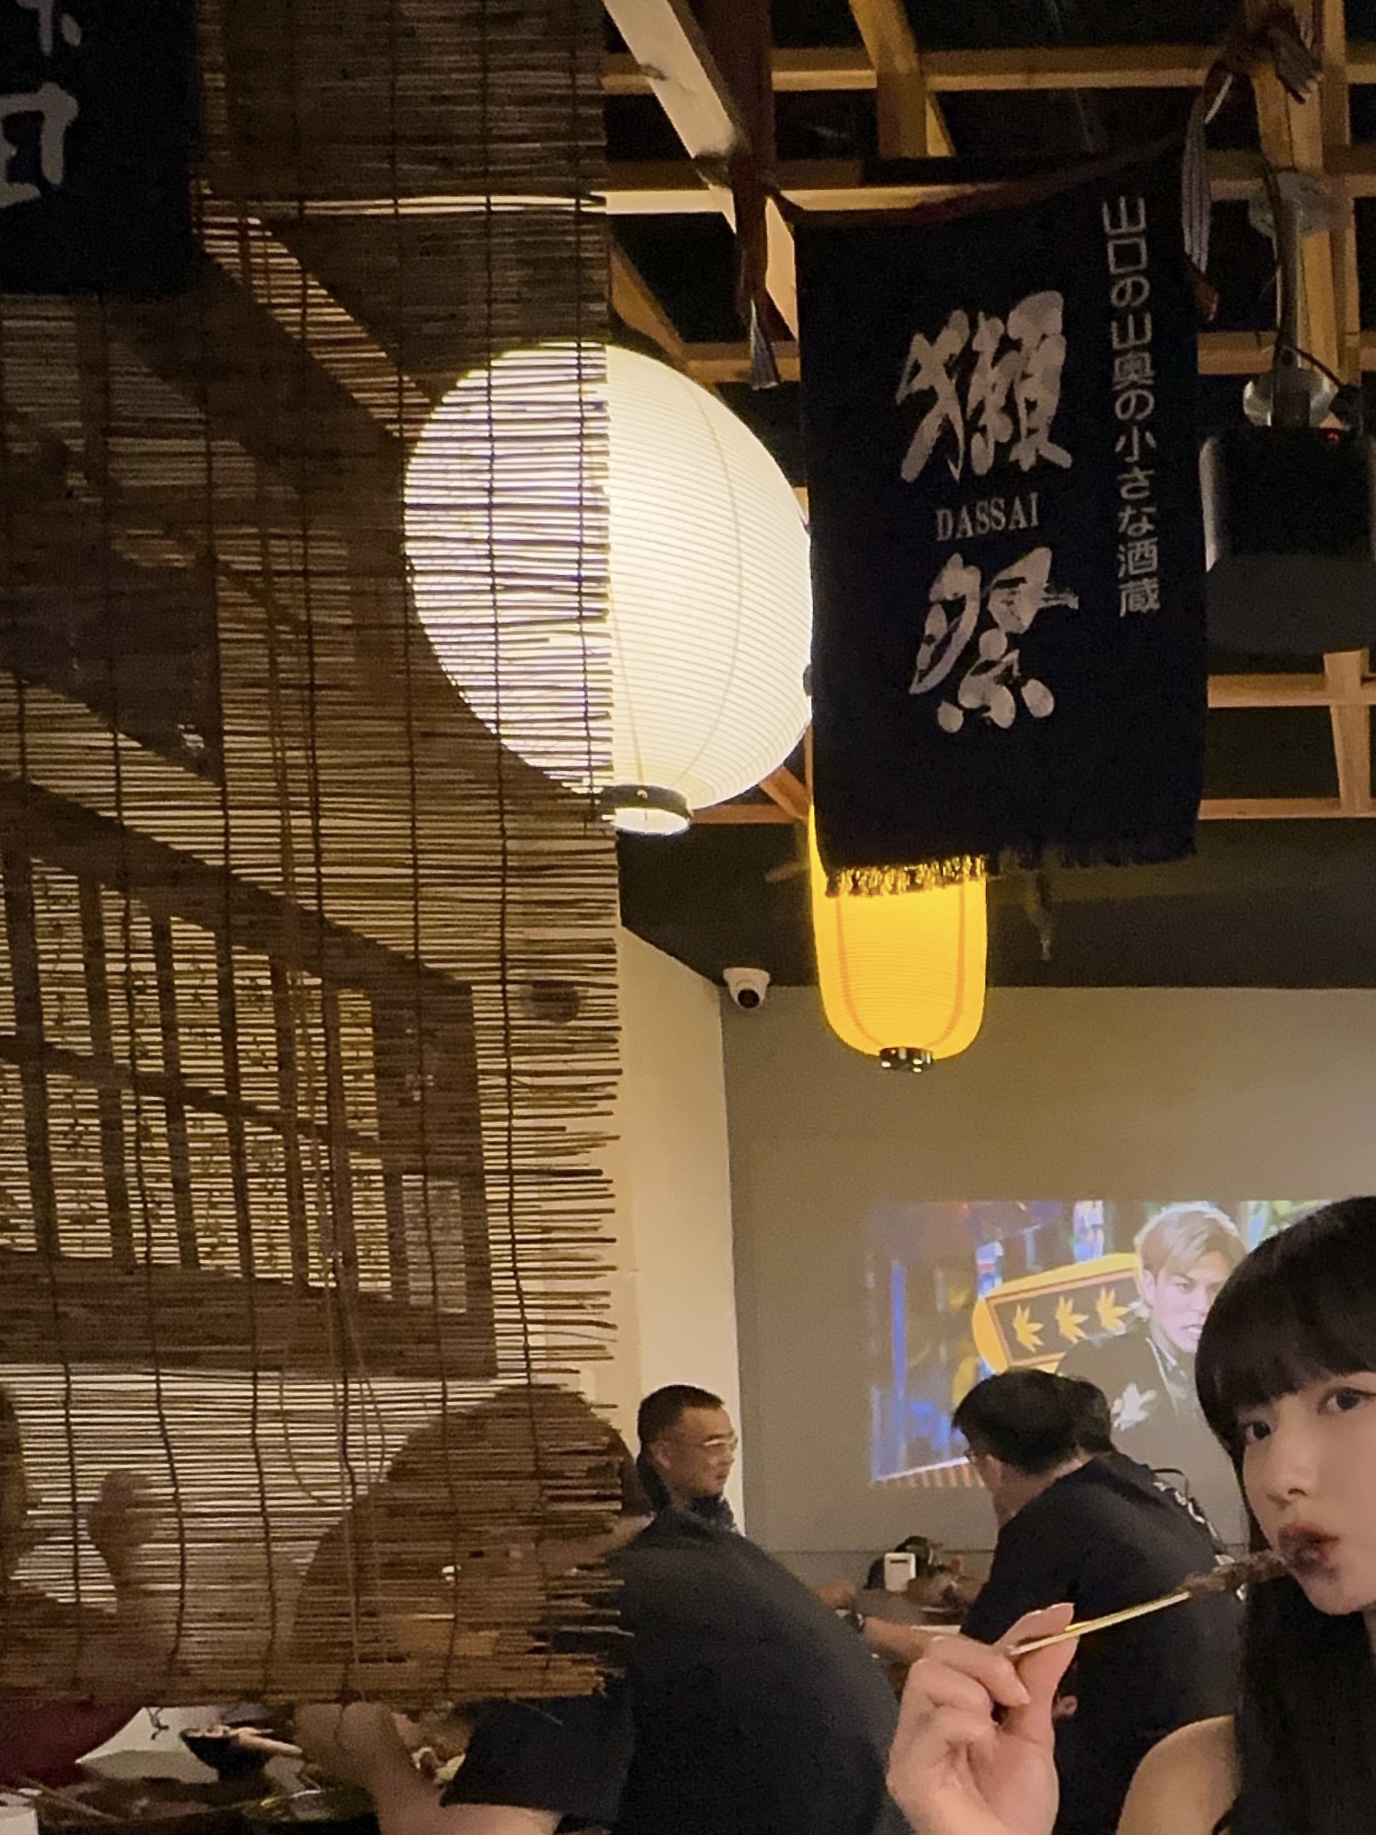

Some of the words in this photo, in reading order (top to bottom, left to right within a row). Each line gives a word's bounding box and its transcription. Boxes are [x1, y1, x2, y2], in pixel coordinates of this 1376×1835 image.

[935, 492, 1040, 543] DASSAI
[1102, 195, 1162, 618] 山口の山奥の小さな酒蔵
